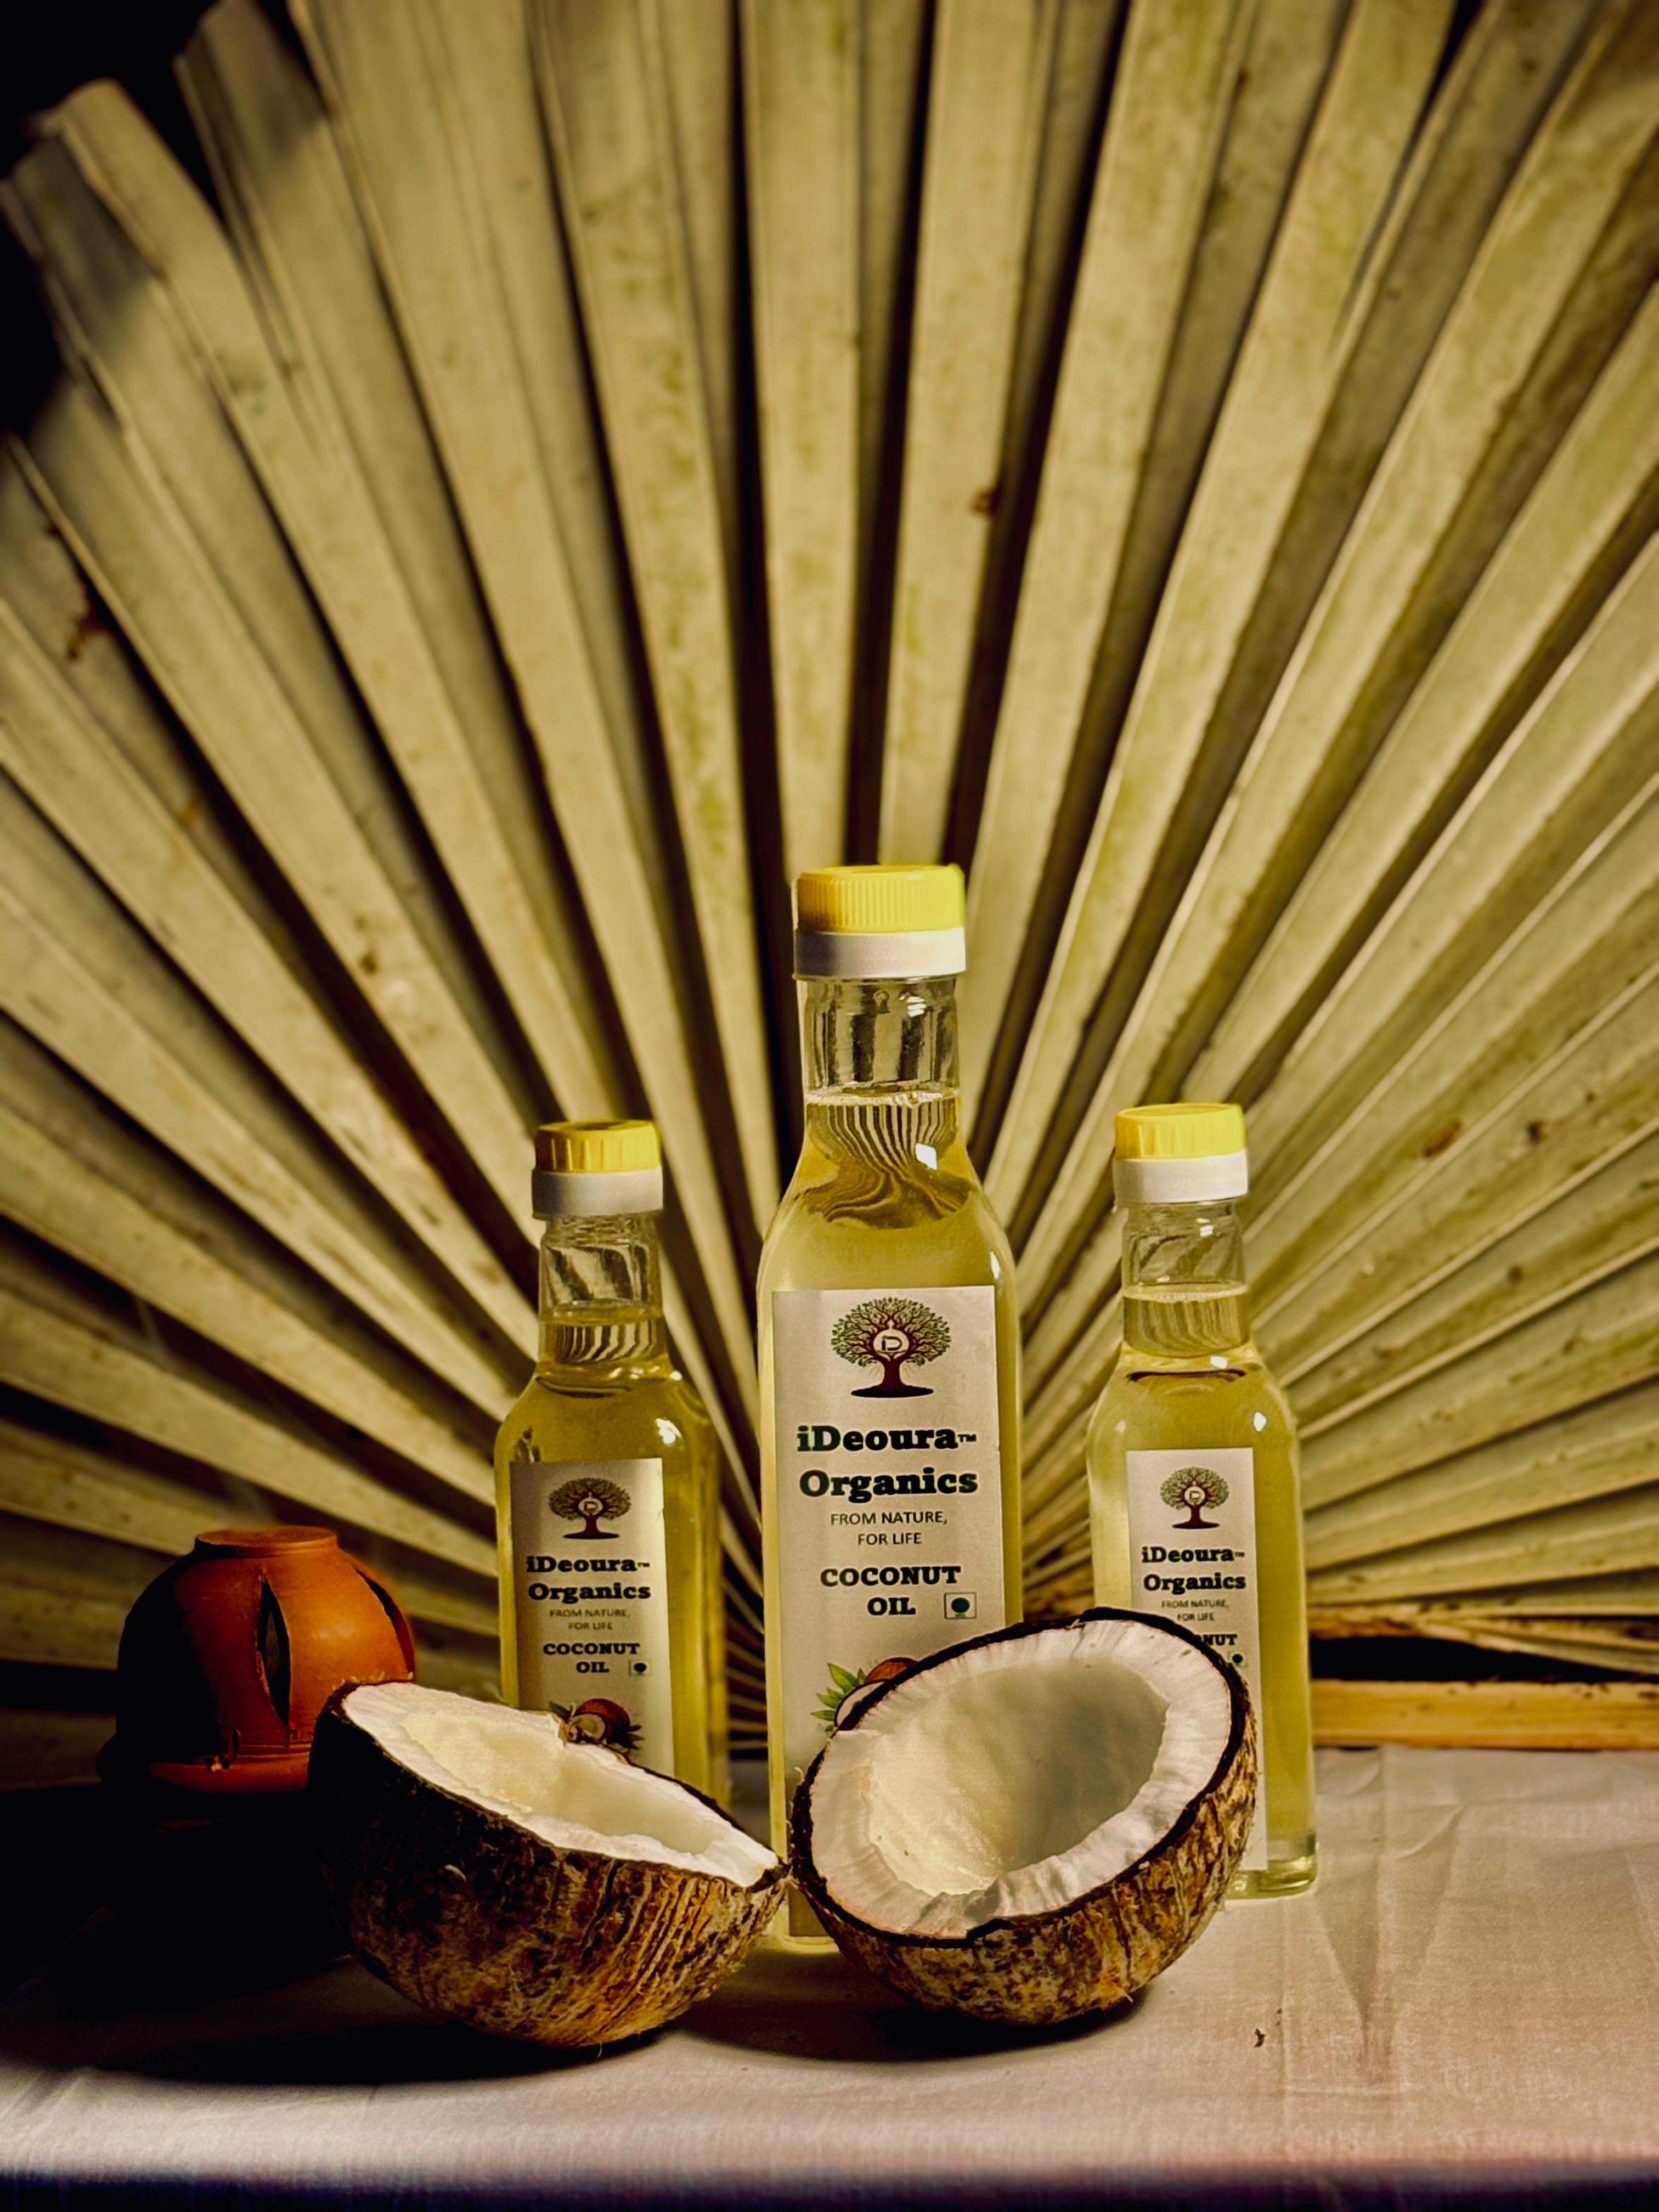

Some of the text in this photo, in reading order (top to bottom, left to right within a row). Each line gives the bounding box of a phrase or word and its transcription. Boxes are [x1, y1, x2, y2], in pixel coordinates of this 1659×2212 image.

[799, 1467, 978, 1503] Organics
[831, 1511, 947, 1525] FROM NATURE,
[858, 1533, 922, 1545] FOR LIFE
[820, 1566, 961, 1587] COCONUT
[1144, 1572, 1246, 1595] Organics
[528, 1582, 651, 1604] Organics
[867, 1597, 916, 1616] OIL
[1161, 1600, 1188, 1608] FROM
[550, 1609, 582, 1617] FROM
[1198, 1612, 1214, 1621] LIFE
[568, 1621, 613, 1630] FOR LIFE
[543, 1643, 640, 1655] COCONUT
[577, 1661, 610, 1673] OIL
